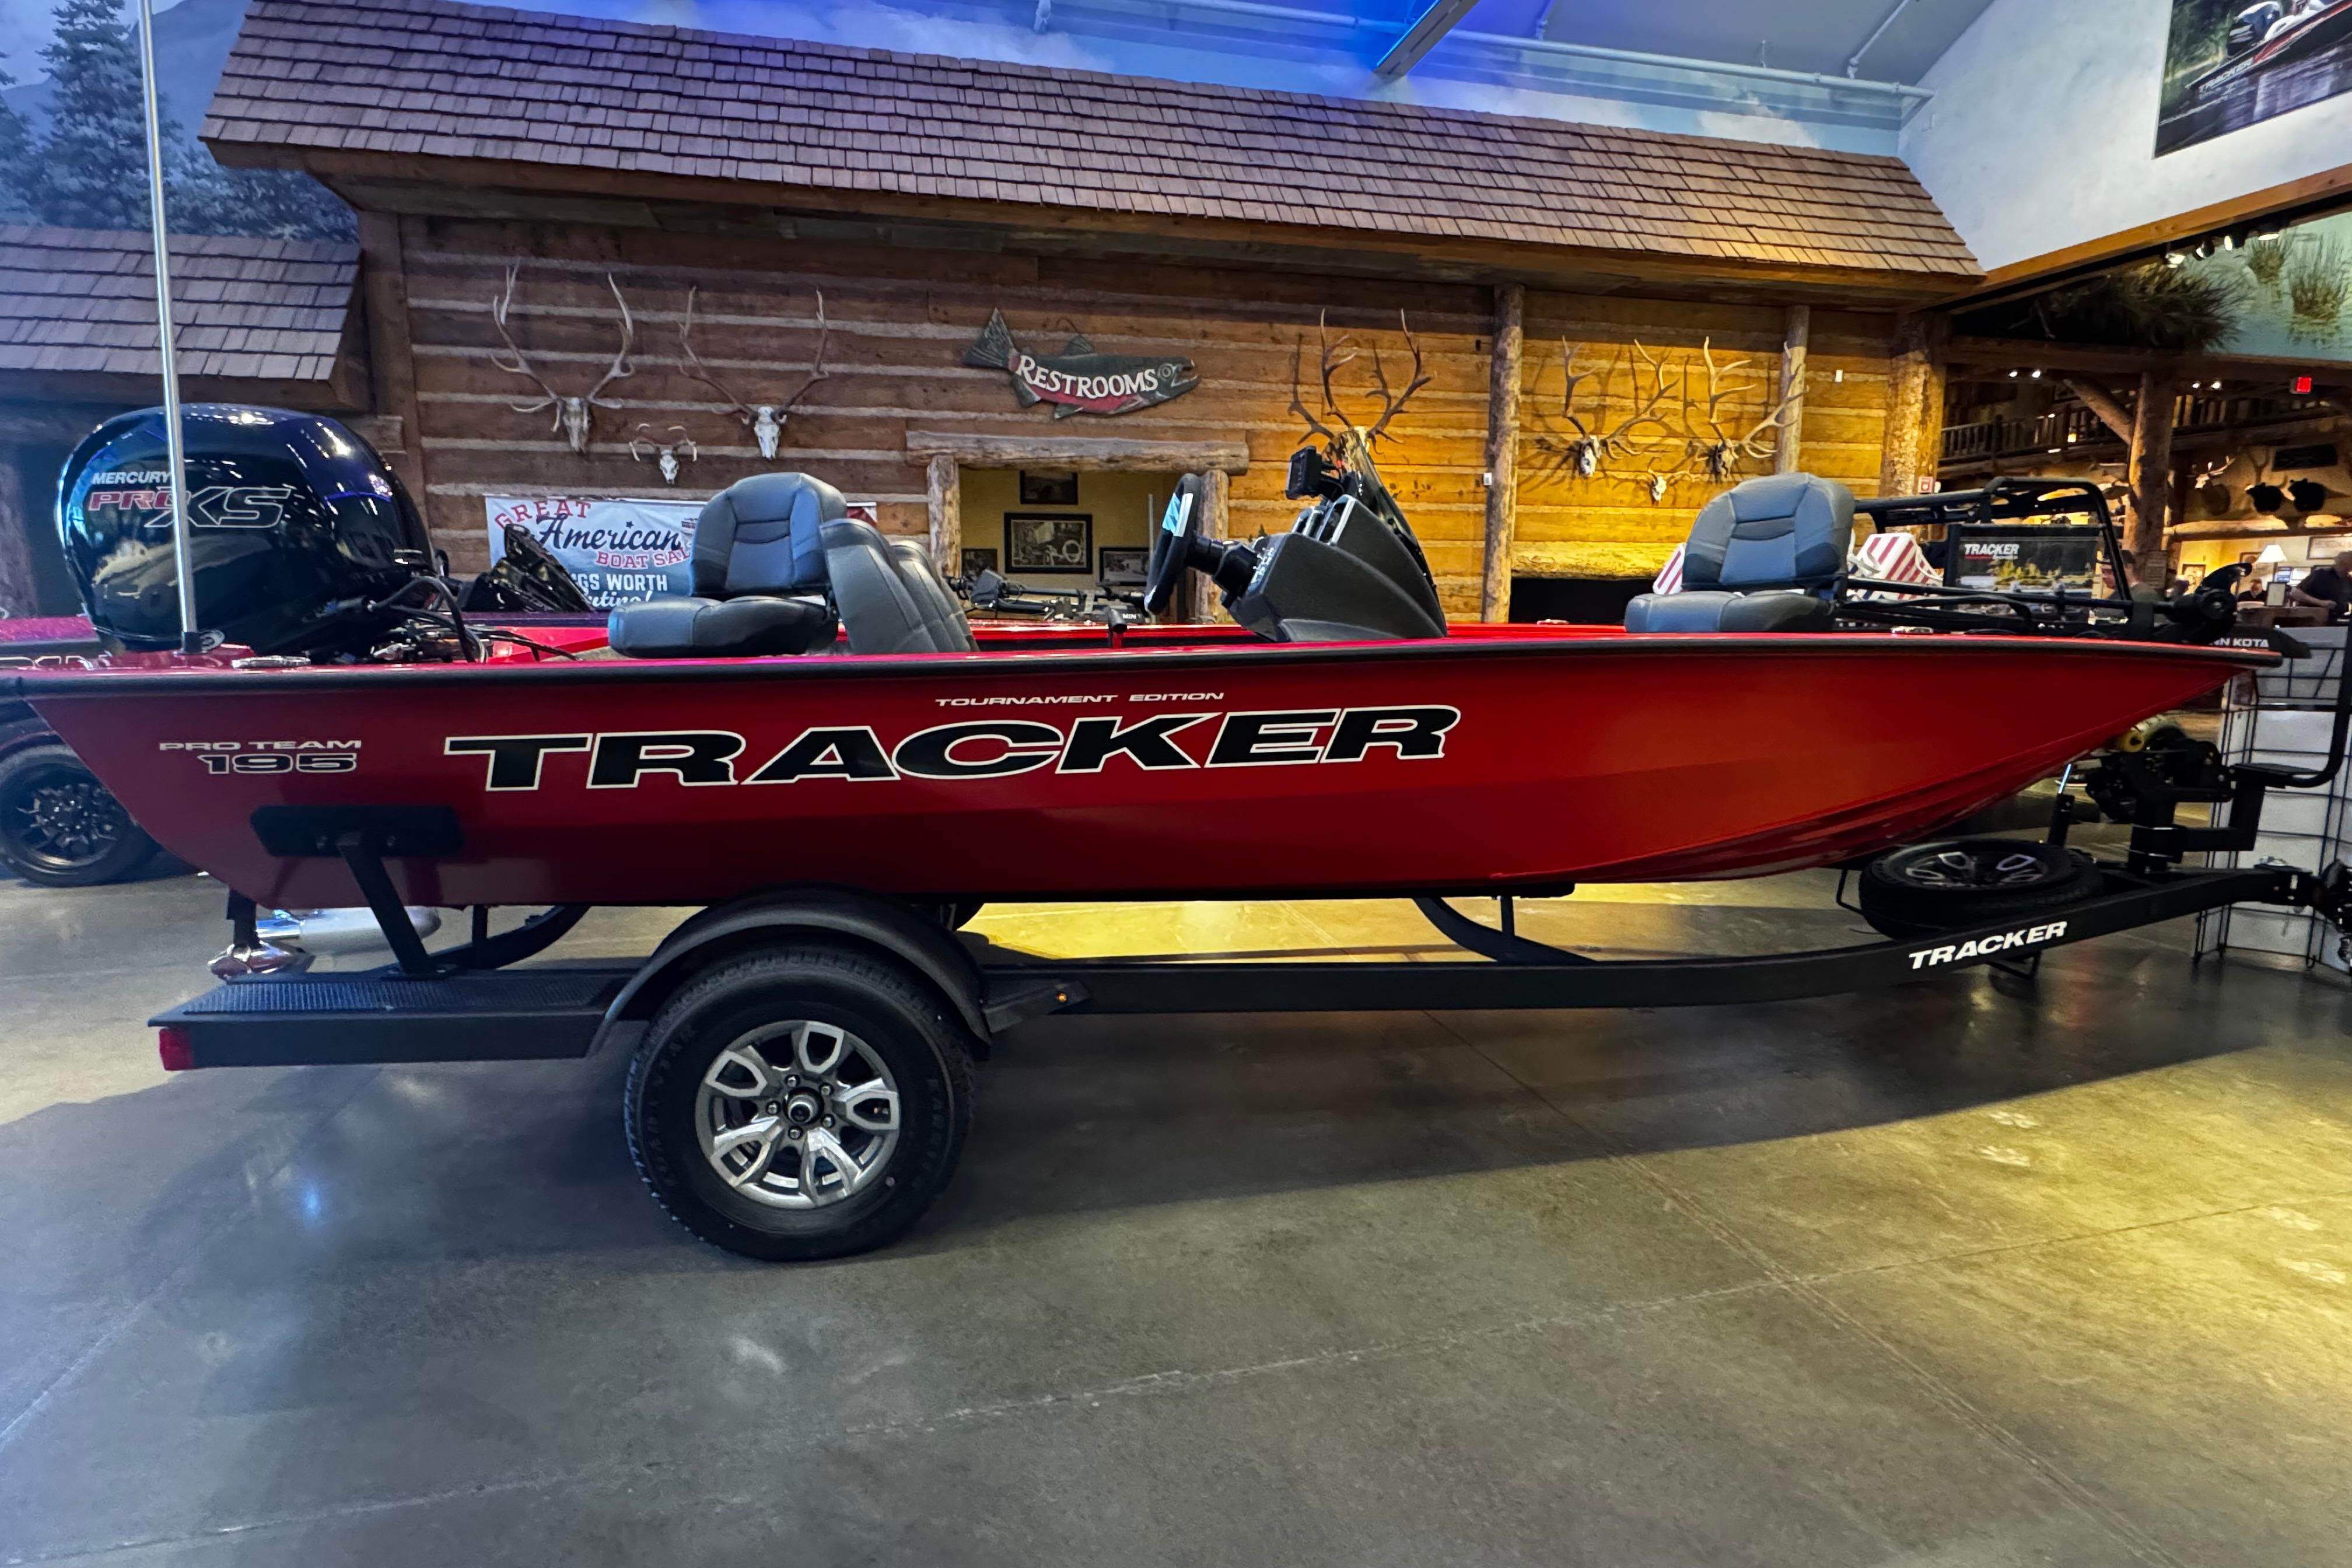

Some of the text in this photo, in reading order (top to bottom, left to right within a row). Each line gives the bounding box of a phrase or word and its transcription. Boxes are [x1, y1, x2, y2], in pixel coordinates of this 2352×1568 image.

[1016, 355, 1158, 399] RESTROOMS
[92, 471, 174, 484] MERCURY
[89, 486, 292, 527] PRO XS
[495, 499, 592, 530] GREAT
[536, 512, 681, 550] American
[596, 546, 691, 569] BOAT SAL
[1964, 544, 2020, 555] TRACKER
[607, 574, 667, 592] WORTH
[2232, 638, 2269, 648] KOTA
[935, 692, 1224, 706] TOURNAMENT EDITION
[159, 740, 362, 751] PRO TEAM
[444, 705, 1461, 792] TRACKER
[197, 753, 357, 774] 195
[1909, 921, 2067, 970] TRACKER
